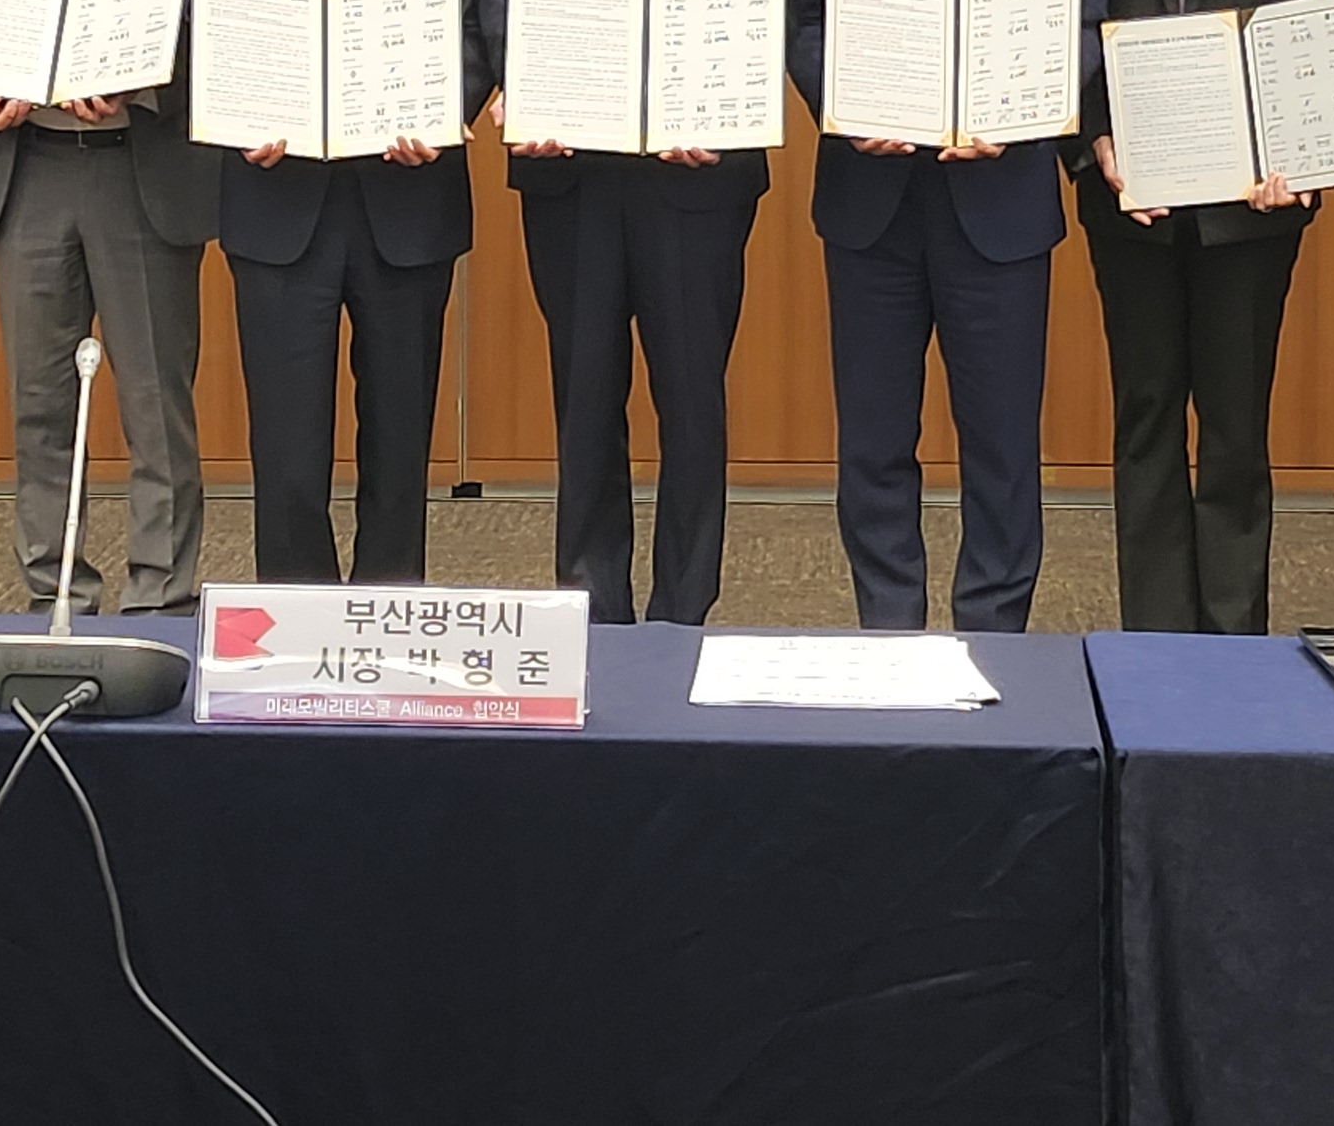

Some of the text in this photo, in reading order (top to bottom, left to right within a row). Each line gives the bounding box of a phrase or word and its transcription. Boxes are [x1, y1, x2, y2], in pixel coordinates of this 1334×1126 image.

[343, 598, 524, 638] 부산광역시
[312, 646, 386, 684] 시장
[266, 697, 521, 721] 미래모빌리티스쿨 Alliance 협약식
